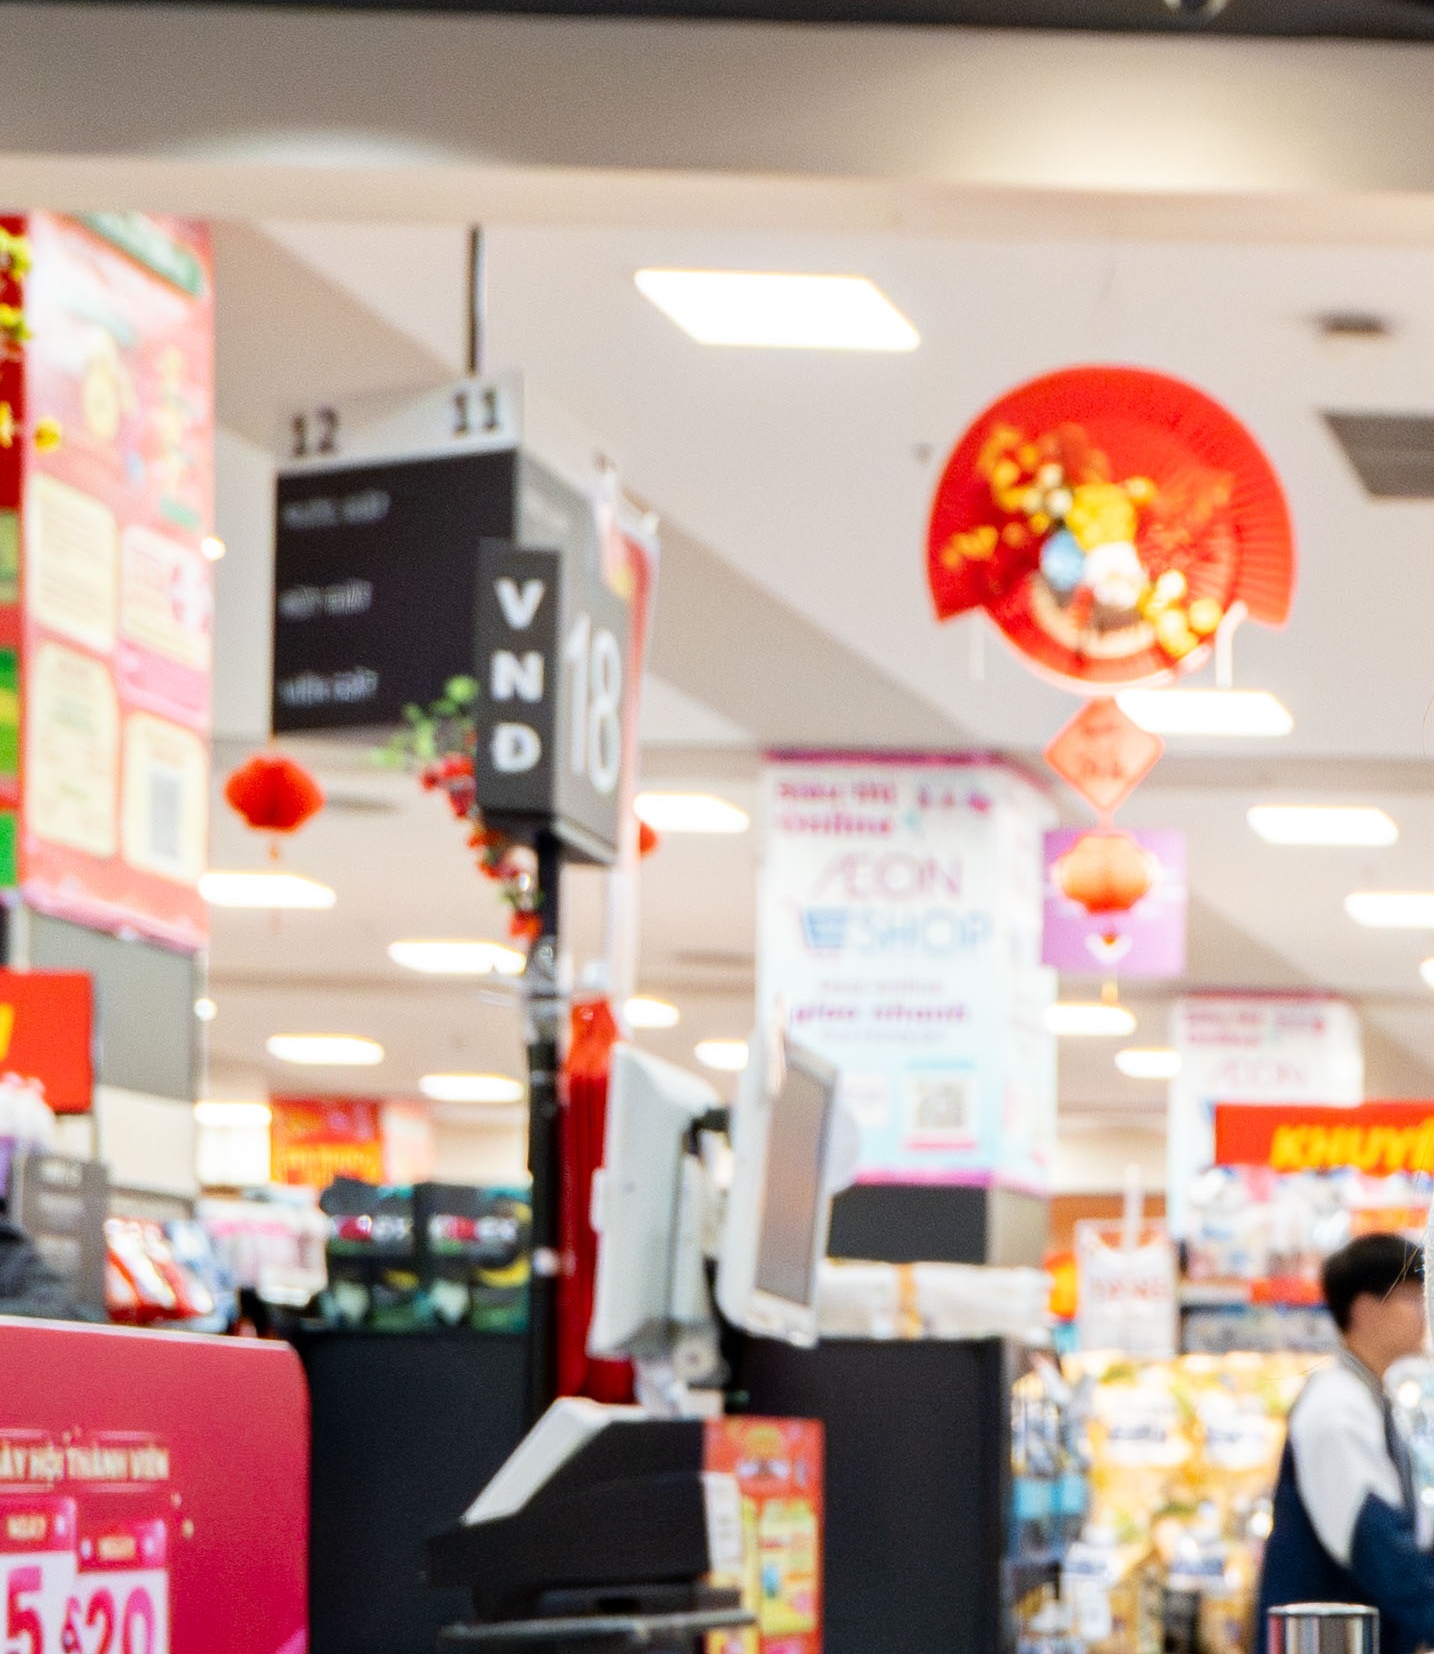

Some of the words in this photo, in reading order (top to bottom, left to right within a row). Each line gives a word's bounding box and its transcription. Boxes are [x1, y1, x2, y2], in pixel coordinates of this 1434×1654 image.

[290, 406, 340, 458] 12
[452, 388, 501, 437] 11
[563, 612, 622, 795] 18
